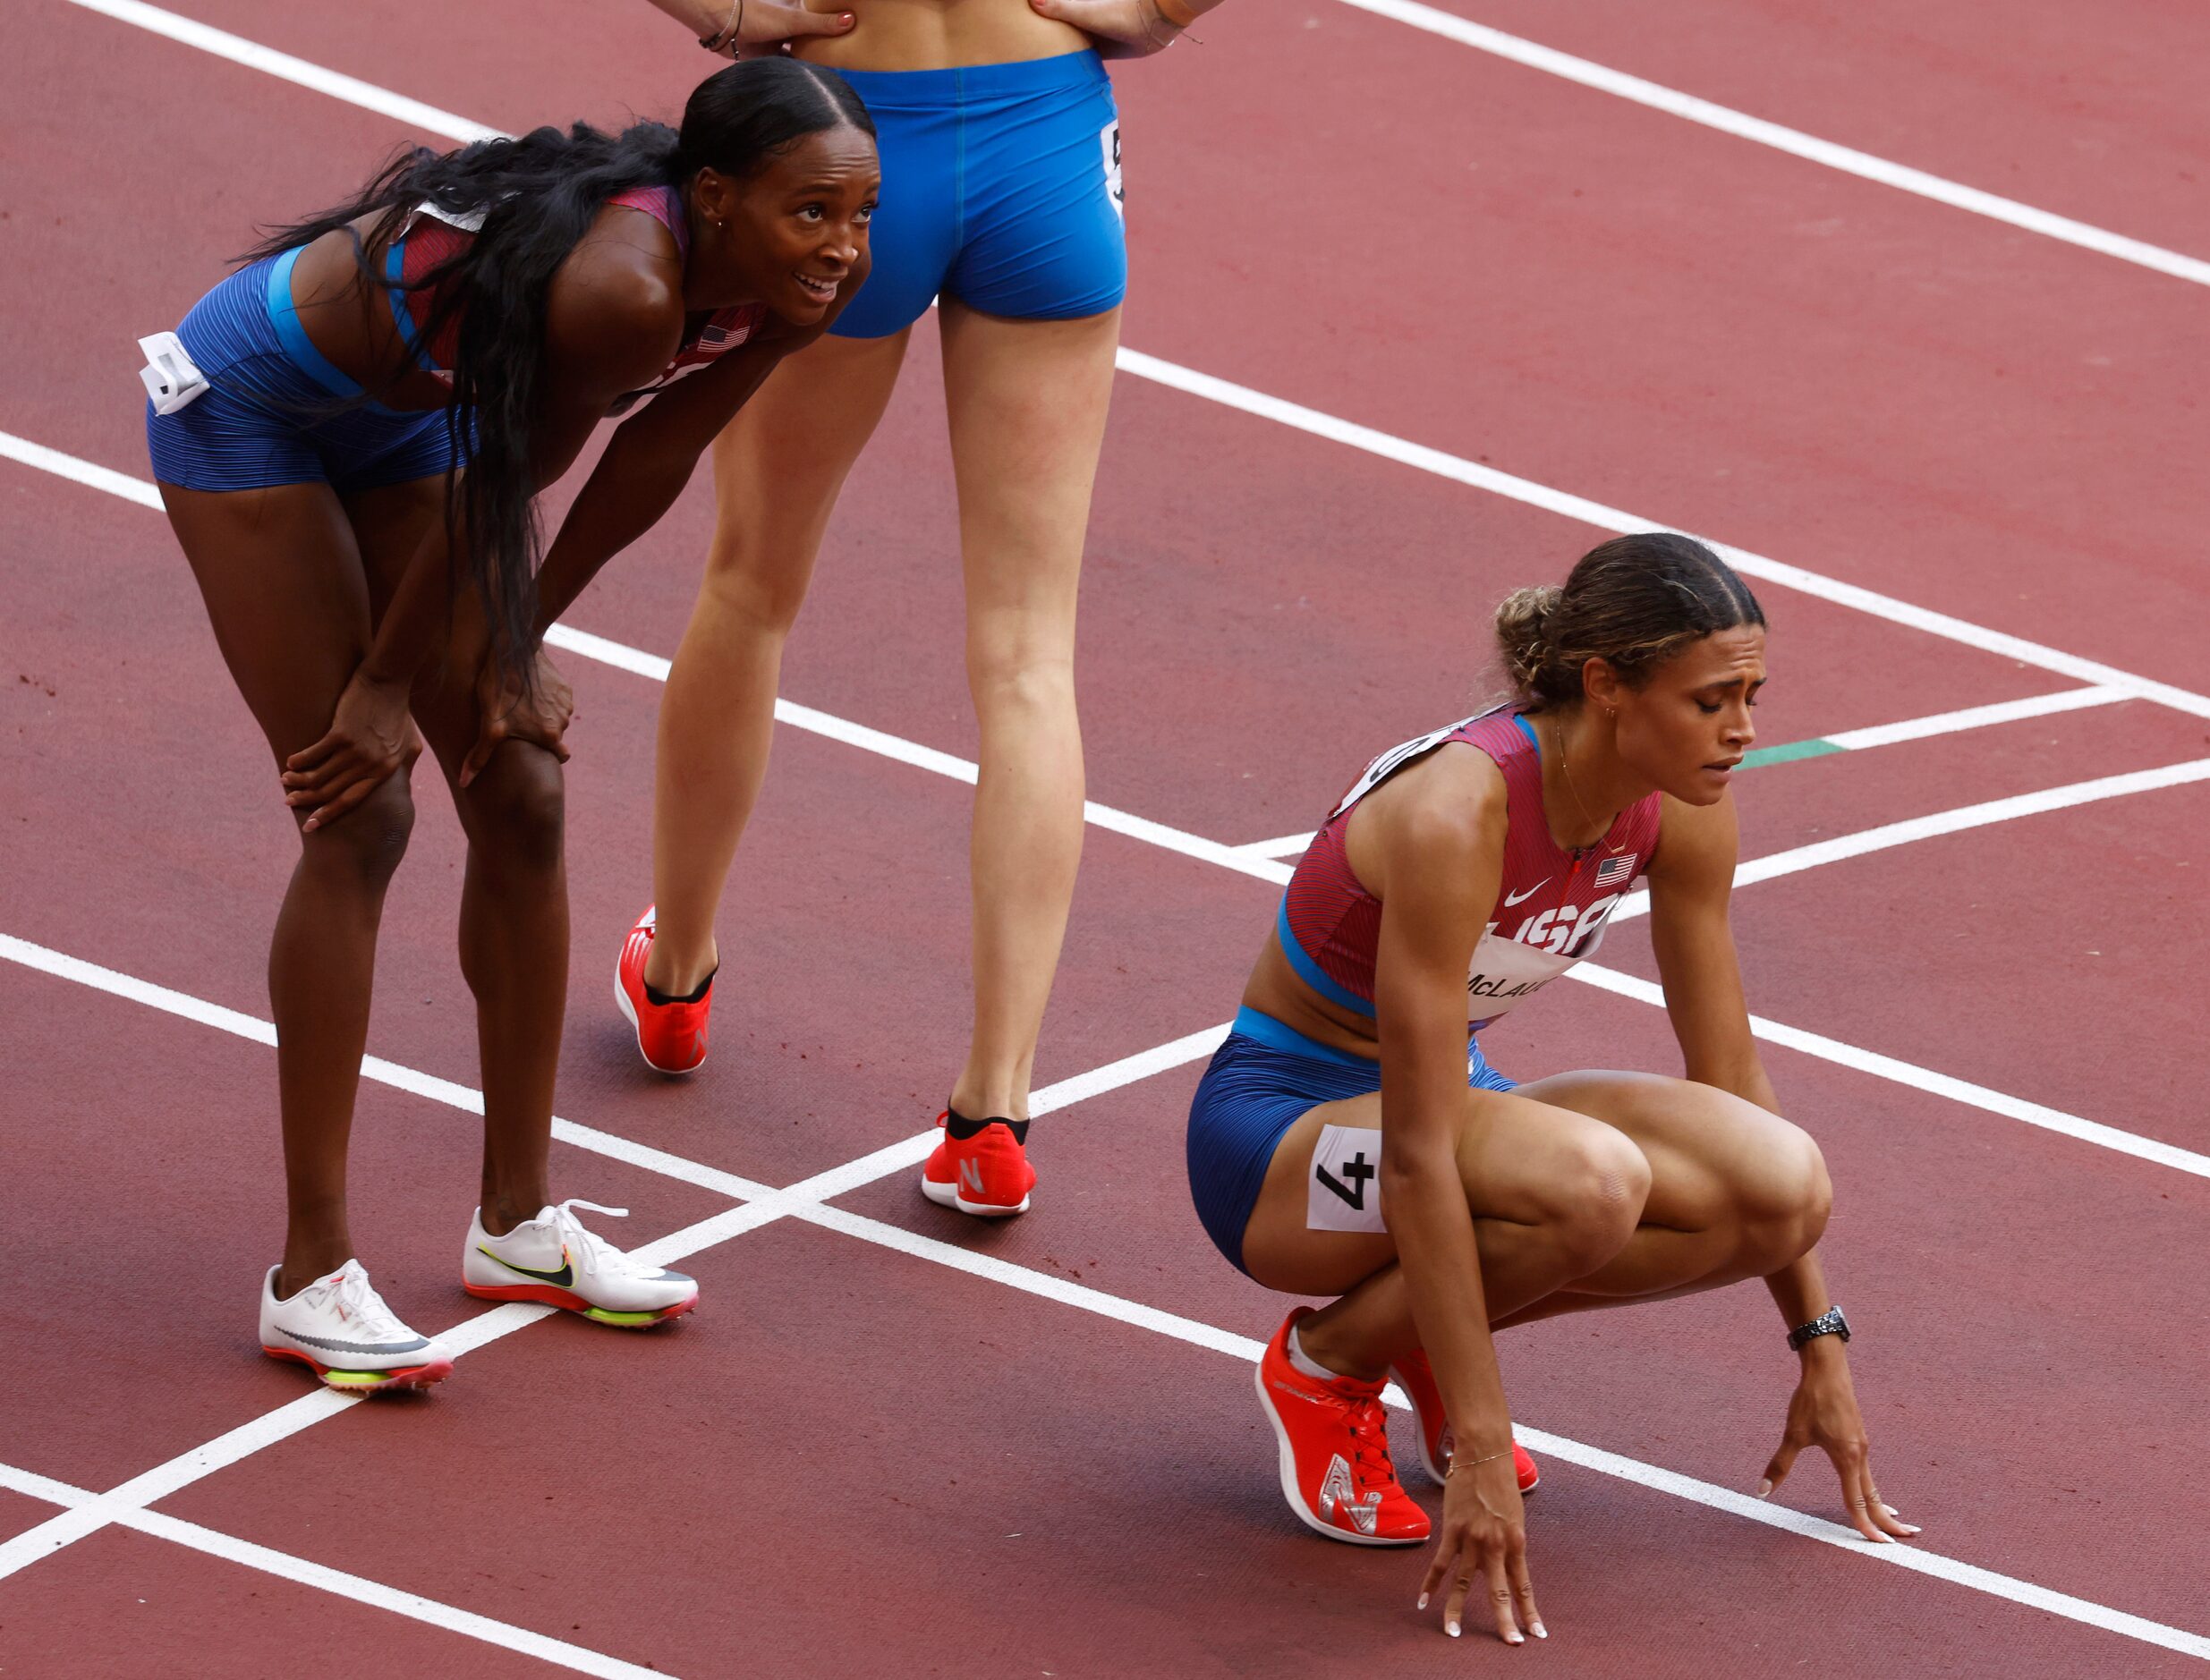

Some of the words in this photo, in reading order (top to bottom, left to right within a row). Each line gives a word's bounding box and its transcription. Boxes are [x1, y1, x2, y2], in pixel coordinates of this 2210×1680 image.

[959, 1158, 986, 1194] N
[1316, 1151, 1375, 1211] 4
[1319, 1453, 1383, 1535] N
